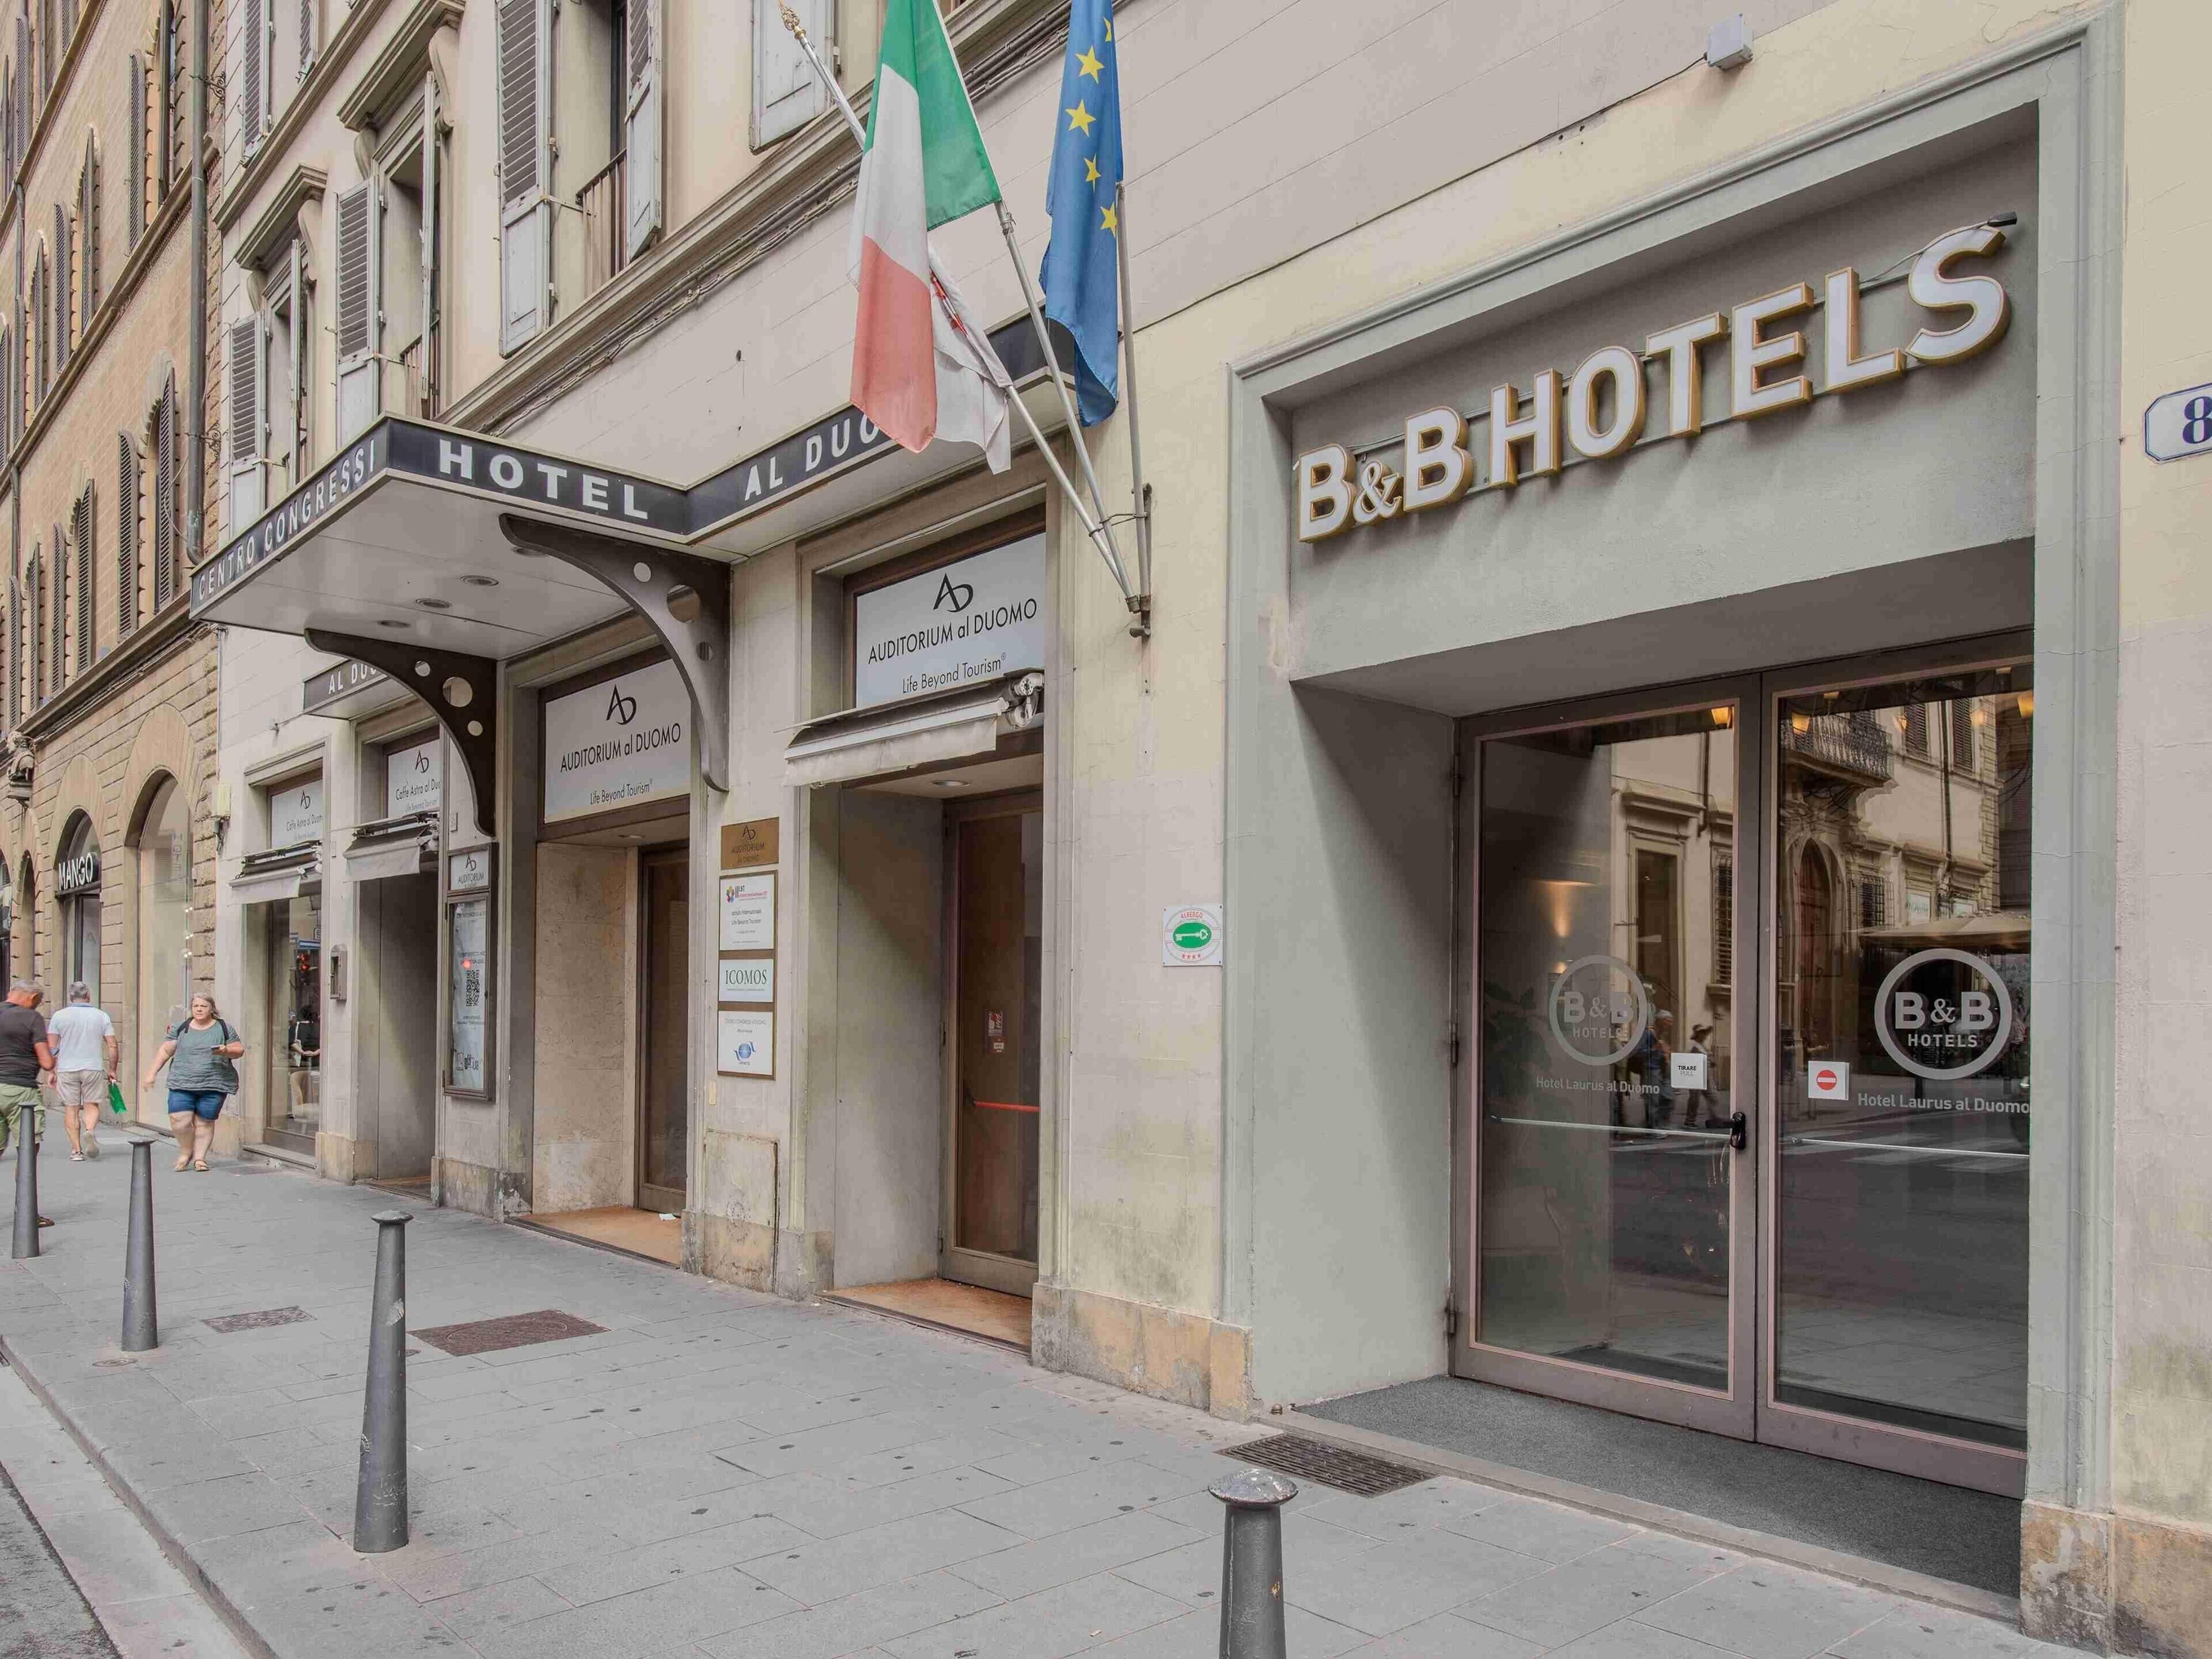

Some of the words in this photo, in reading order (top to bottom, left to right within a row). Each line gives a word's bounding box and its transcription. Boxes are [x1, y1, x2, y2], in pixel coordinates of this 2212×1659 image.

[1298, 406, 1473, 544] B&B
[1488, 226, 2013, 489] HOTELS
[744, 456, 783, 501] AL
[805, 412, 880, 472] DUO
[440, 438, 649, 520] HOTEL
[198, 536, 255, 600] CENTRO
[264, 437, 375, 552] CONGRESSI
[868, 622, 953, 664] AUDITORIUM
[957, 616, 969, 639] al
[974, 598, 1037, 634] DUOMO
[328, 670, 344, 695] AL
[903, 675, 918, 694] Life
[922, 663, 959, 690] Beyond
[560, 738, 622, 772] AUDITORIUM
[624, 734, 633, 756] al
[636, 722, 681, 753] DUOMO
[590, 790, 600, 805] Life
[601, 784, 625, 805] Beyond
[59, 853, 93, 891] MANGO
[457, 872, 484, 884] AUDITORIUM
[725, 969, 767, 984] ICOMOS
[1564, 991, 1634, 1023] B&B
[1895, 991, 1993, 1029] B&B
[1573, 1027, 1623, 1038] HOTELS
[1907, 1033, 1978, 1048] HOTELS
[1536, 1076, 1563, 1089] Hotel
[1566, 1078, 1604, 1090] Laurus
[1607, 1080, 1617, 1092] al
[1619, 1081, 1660, 1094] Duomo
[1858, 1093, 1896, 1107] Hotel
[1900, 1095, 1952, 1110] Laurus
[1956, 1097, 1969, 1111] al
[1974, 1098, 2031, 1113] Duomo
